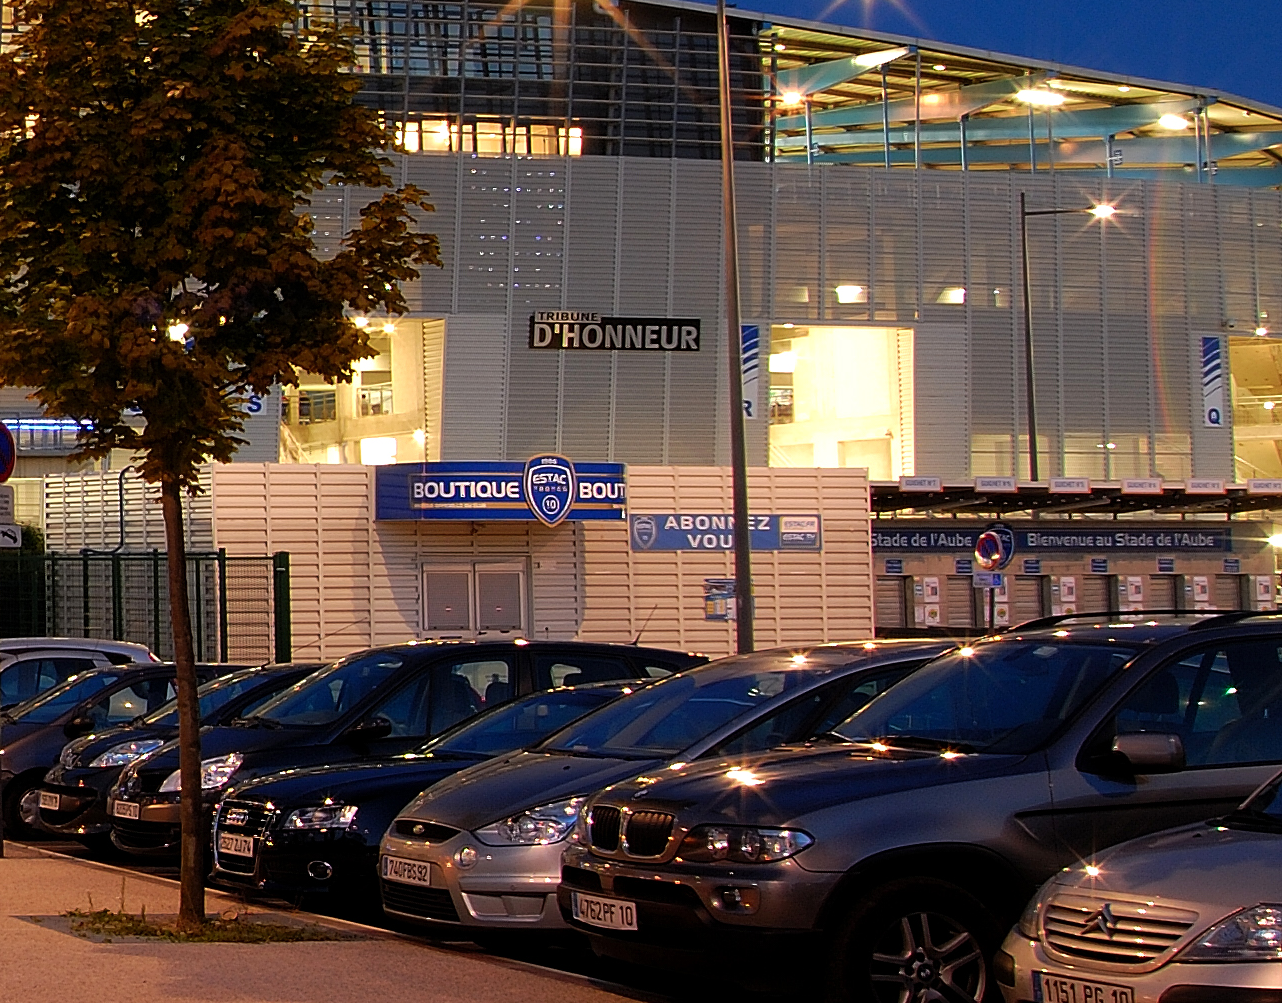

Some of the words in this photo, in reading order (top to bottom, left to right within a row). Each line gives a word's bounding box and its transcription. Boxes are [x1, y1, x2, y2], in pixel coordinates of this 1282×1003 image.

[537, 311, 599, 322] TRIBUNE
[533, 324, 698, 350] D'HONNEUR
[247, 394, 262, 413] S
[1208, 407, 1221, 426] Q
[532, 473, 567, 484] ESTAC
[413, 481, 520, 498] BOUTIQUE
[545, 499, 557, 510] 10
[687, 534, 734, 548] VOU
[911, 533, 927, 546] de
[930, 533, 972, 546] l'Aube
[1027, 533, 1094, 546] Bienvenue
[1095, 536, 1112, 546] au
[1115, 533, 1154, 546] Stade
[1156, 533, 1172, 546] de
[1174, 533, 1214, 546] l'Aube
[1044, 978, 1076, 1003] 1151
